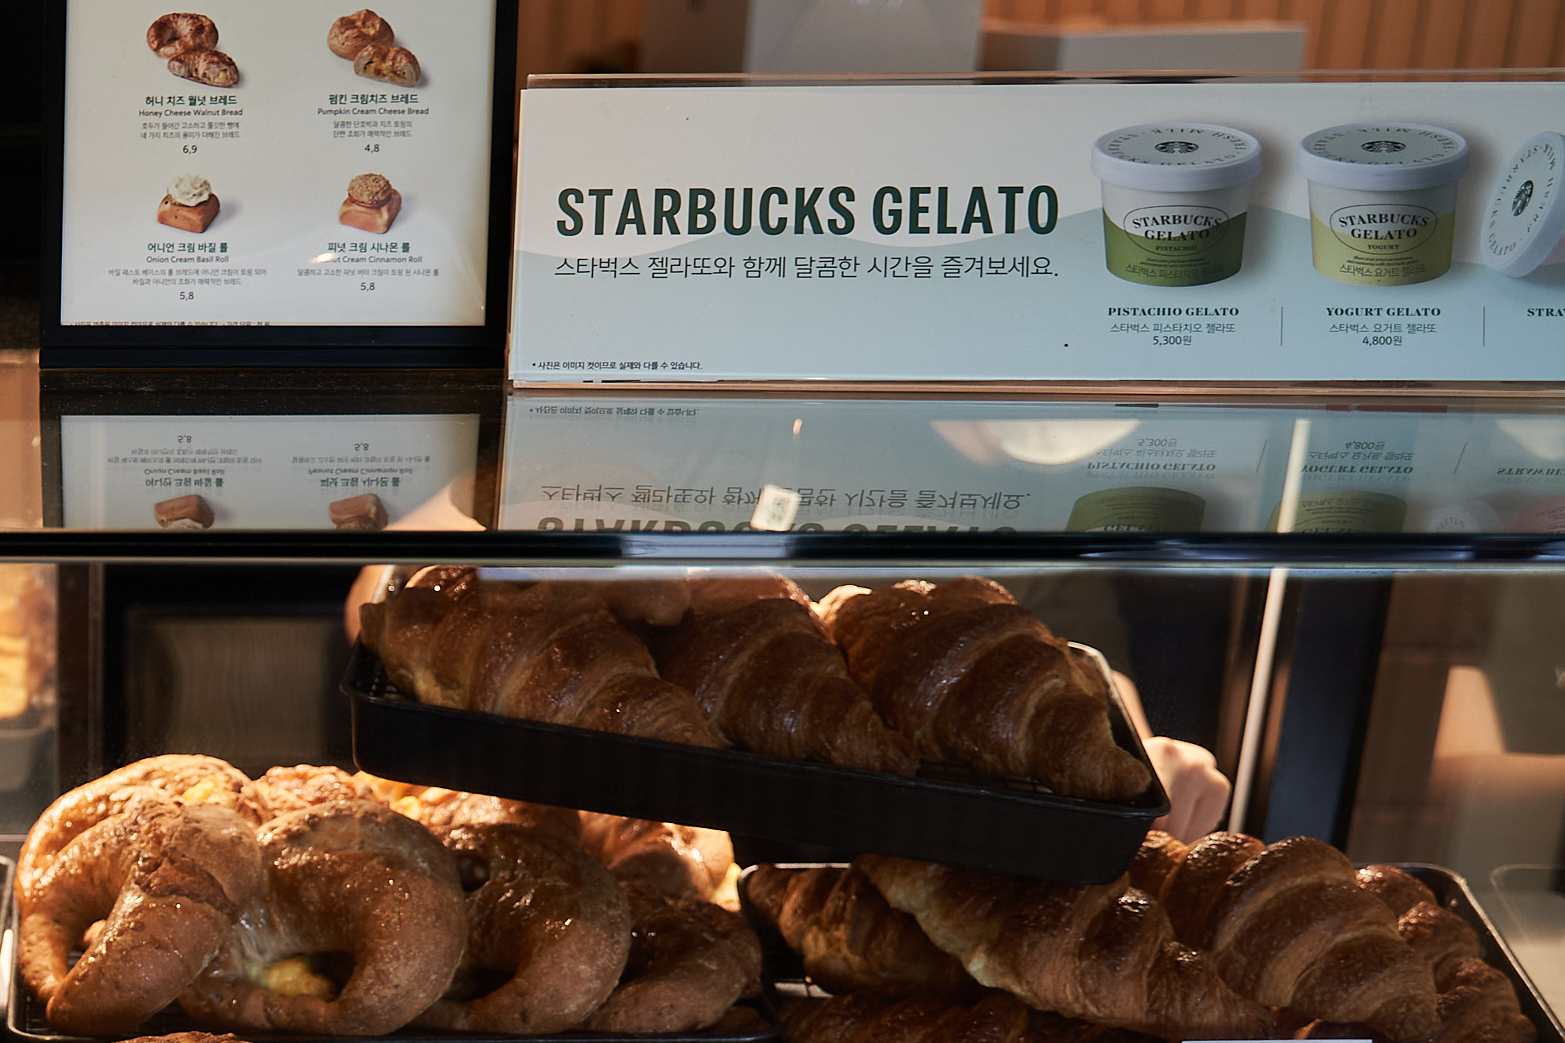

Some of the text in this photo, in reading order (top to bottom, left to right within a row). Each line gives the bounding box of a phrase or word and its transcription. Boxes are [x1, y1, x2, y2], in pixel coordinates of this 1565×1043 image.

[145, 95, 237, 107] 허니 치즈 월넛 브레드
[329, 94, 418, 105] 펌킨 크림치즈 브레드
[139, 110, 162, 118] Honey
[556, 185, 1060, 237] STARBUCKS GELATO
[1132, 215, 1222, 229] STARBUCKS
[1339, 213, 1429, 227] STARBUCKS
[1144, 229, 1210, 241] GELATO
[1351, 229, 1417, 240] GELATO
[148, 243, 228, 253] 어니언 크림 바질 롤
[328, 243, 410, 253] 피넛 크림 시나몬 롤
[555, 255, 1059, 279] 스타벅스 젤라또와 함께 달콤한 시간을 즐겨보세요.
[1108, 308, 1239, 316] PISTACHIO GELATO
[1326, 308, 1441, 316] YOGURT GELATO
[1110, 324, 1236, 333] 스타벅스 피스타치오 젤라또
[1329, 324, 1436, 333] 스타벅스 요거트 젤라또
[1153, 335, 1192, 346] 5,300원
[1362, 336, 1402, 346] 4,800원
[538, 362, 560, 370] 사진은
[563, 362, 585, 370] 이미지
[619, 362, 641, 370] 실제와
[643, 361, 658, 370] 다를
[661, 362, 668, 370] 수
[671, 361, 702, 370] 있습니다.
